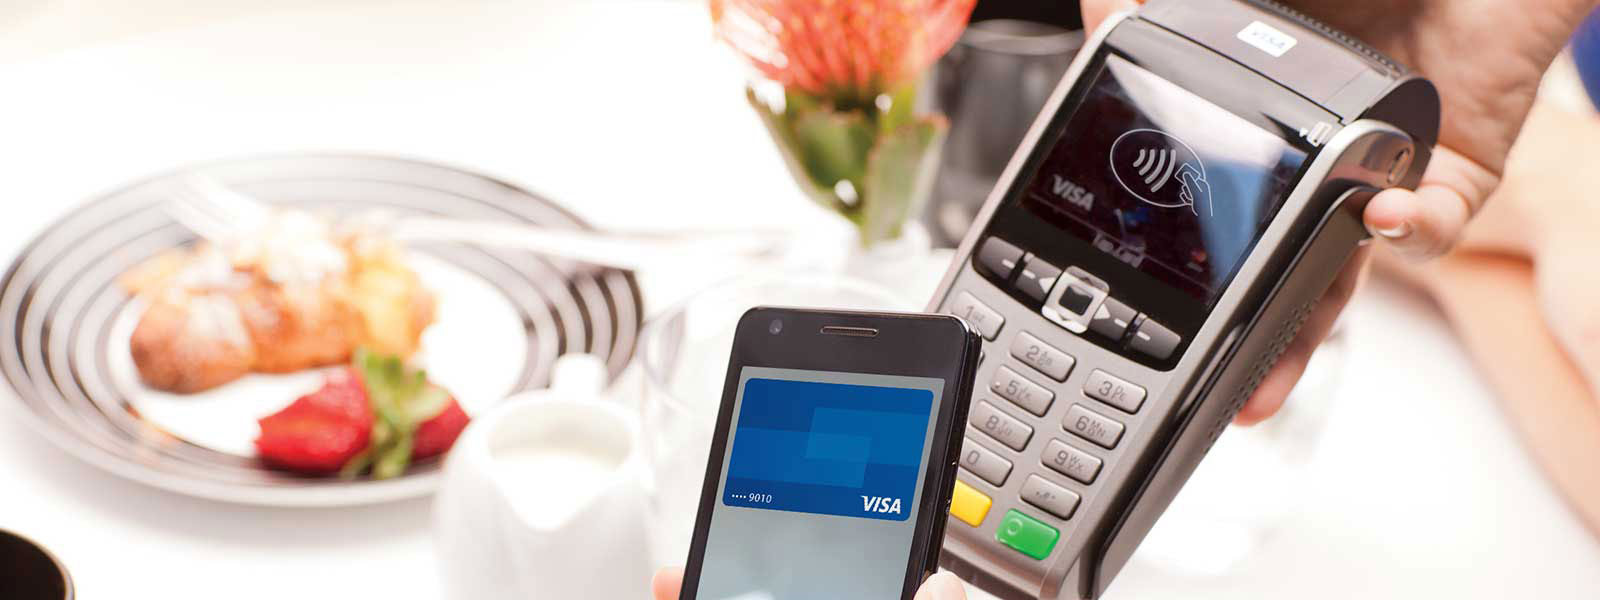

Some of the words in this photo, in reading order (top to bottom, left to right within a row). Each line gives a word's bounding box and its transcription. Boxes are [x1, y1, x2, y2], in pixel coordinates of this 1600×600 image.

[1052, 174, 1095, 212] VISA
[1025, 344, 1040, 361] 2
[1006, 379, 1020, 396] 5
[1098, 380, 1113, 397] 3
[985, 415, 1000, 431] 8
[1075, 415, 1090, 432] 6
[1054, 449, 1069, 466] 9
[748, 492, 772, 504] 9010
[860, 494, 902, 515] VISA
